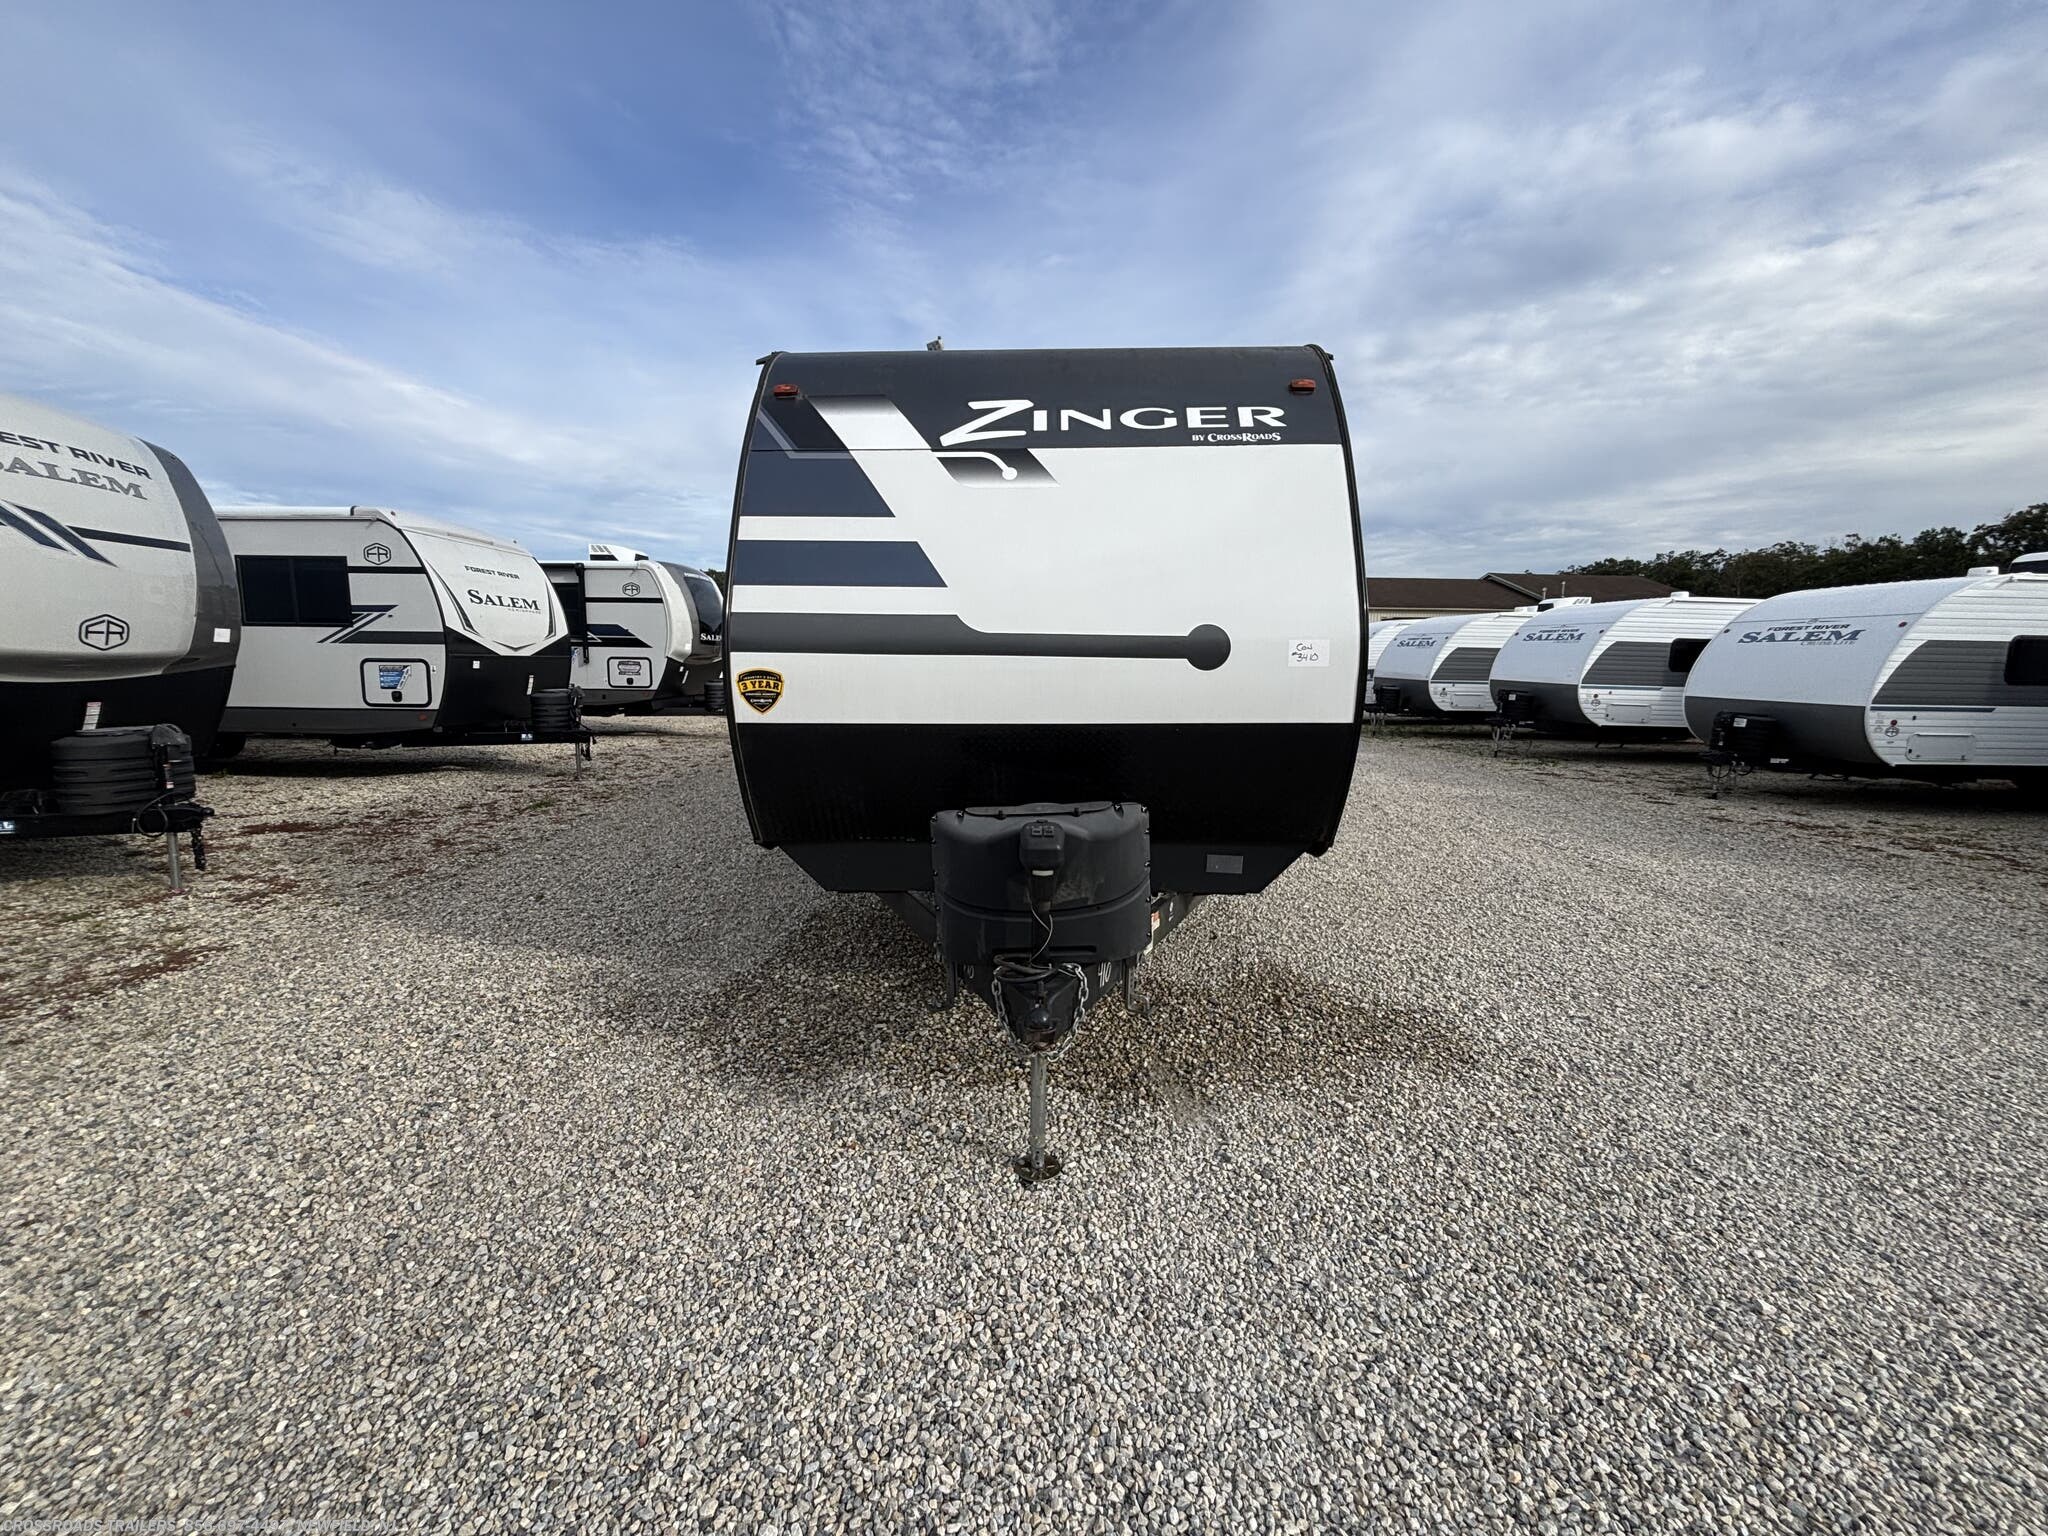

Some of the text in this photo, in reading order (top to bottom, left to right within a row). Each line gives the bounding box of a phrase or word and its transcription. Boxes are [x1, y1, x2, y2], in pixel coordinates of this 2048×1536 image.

[939, 398, 1287, 447] ZINGER
[1192, 432, 1281, 442] BY CROSSROADS
[66, 445, 152, 480] RIVER
[0, 457, 148, 500] ALEM
[464, 565, 520, 580] FOREST RIVER
[467, 589, 541, 611] SALEM
[1522, 633, 1586, 641] SALEM
[1737, 629, 1866, 643] SALEM
[750, 680, 780, 690] YEAR
